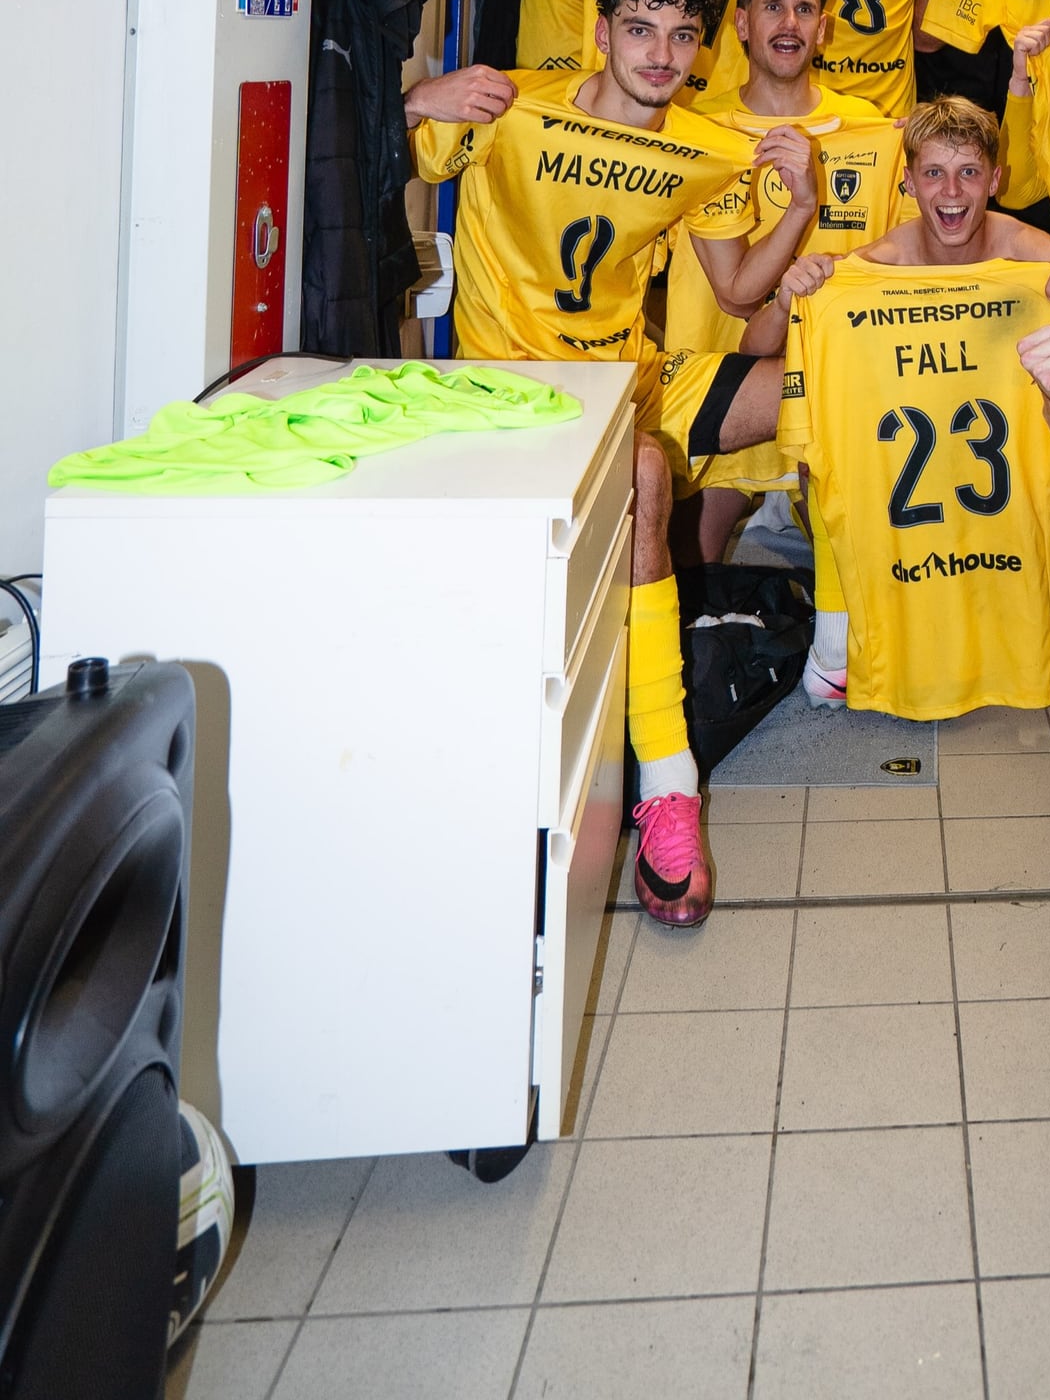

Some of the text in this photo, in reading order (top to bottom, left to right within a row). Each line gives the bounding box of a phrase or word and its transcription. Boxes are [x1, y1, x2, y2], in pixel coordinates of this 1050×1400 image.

[956, 9, 976, 25] Dialog
[562, 119, 706, 160] INTERSPORT
[535, 150, 685, 199] MASROUR
[823, 207, 867, 219] Temporis
[851, 221, 865, 229] CDI
[554, 214, 615, 313] 9
[882, 284, 980, 296] TRAVAIL, RESPECT, HUMILITÉ
[870, 300, 1016, 326] INTERSPORT
[895, 340, 978, 378] FALL
[877, 398, 1011, 529] 23
